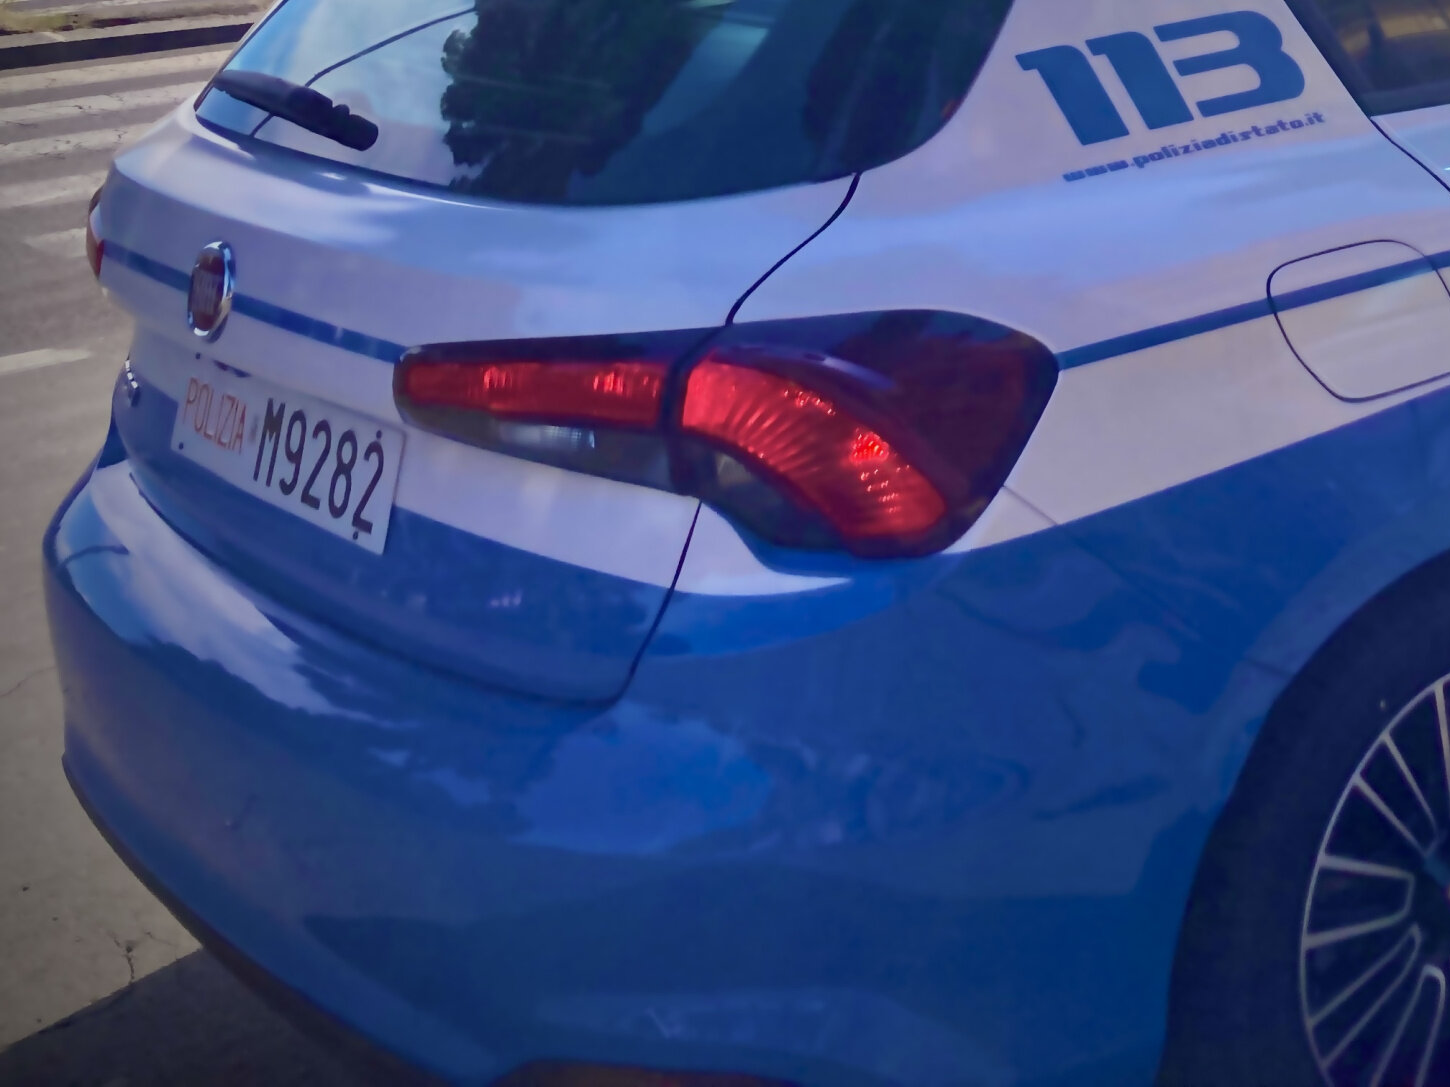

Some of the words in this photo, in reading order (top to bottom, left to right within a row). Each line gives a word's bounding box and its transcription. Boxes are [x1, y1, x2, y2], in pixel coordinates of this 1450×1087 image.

[1014, 10, 1306, 146] 113
[1062, 112, 1327, 183] www.poliziadistato.it
[183, 377, 248, 454] POLIZIA
[252, 397, 385, 535] M9282
